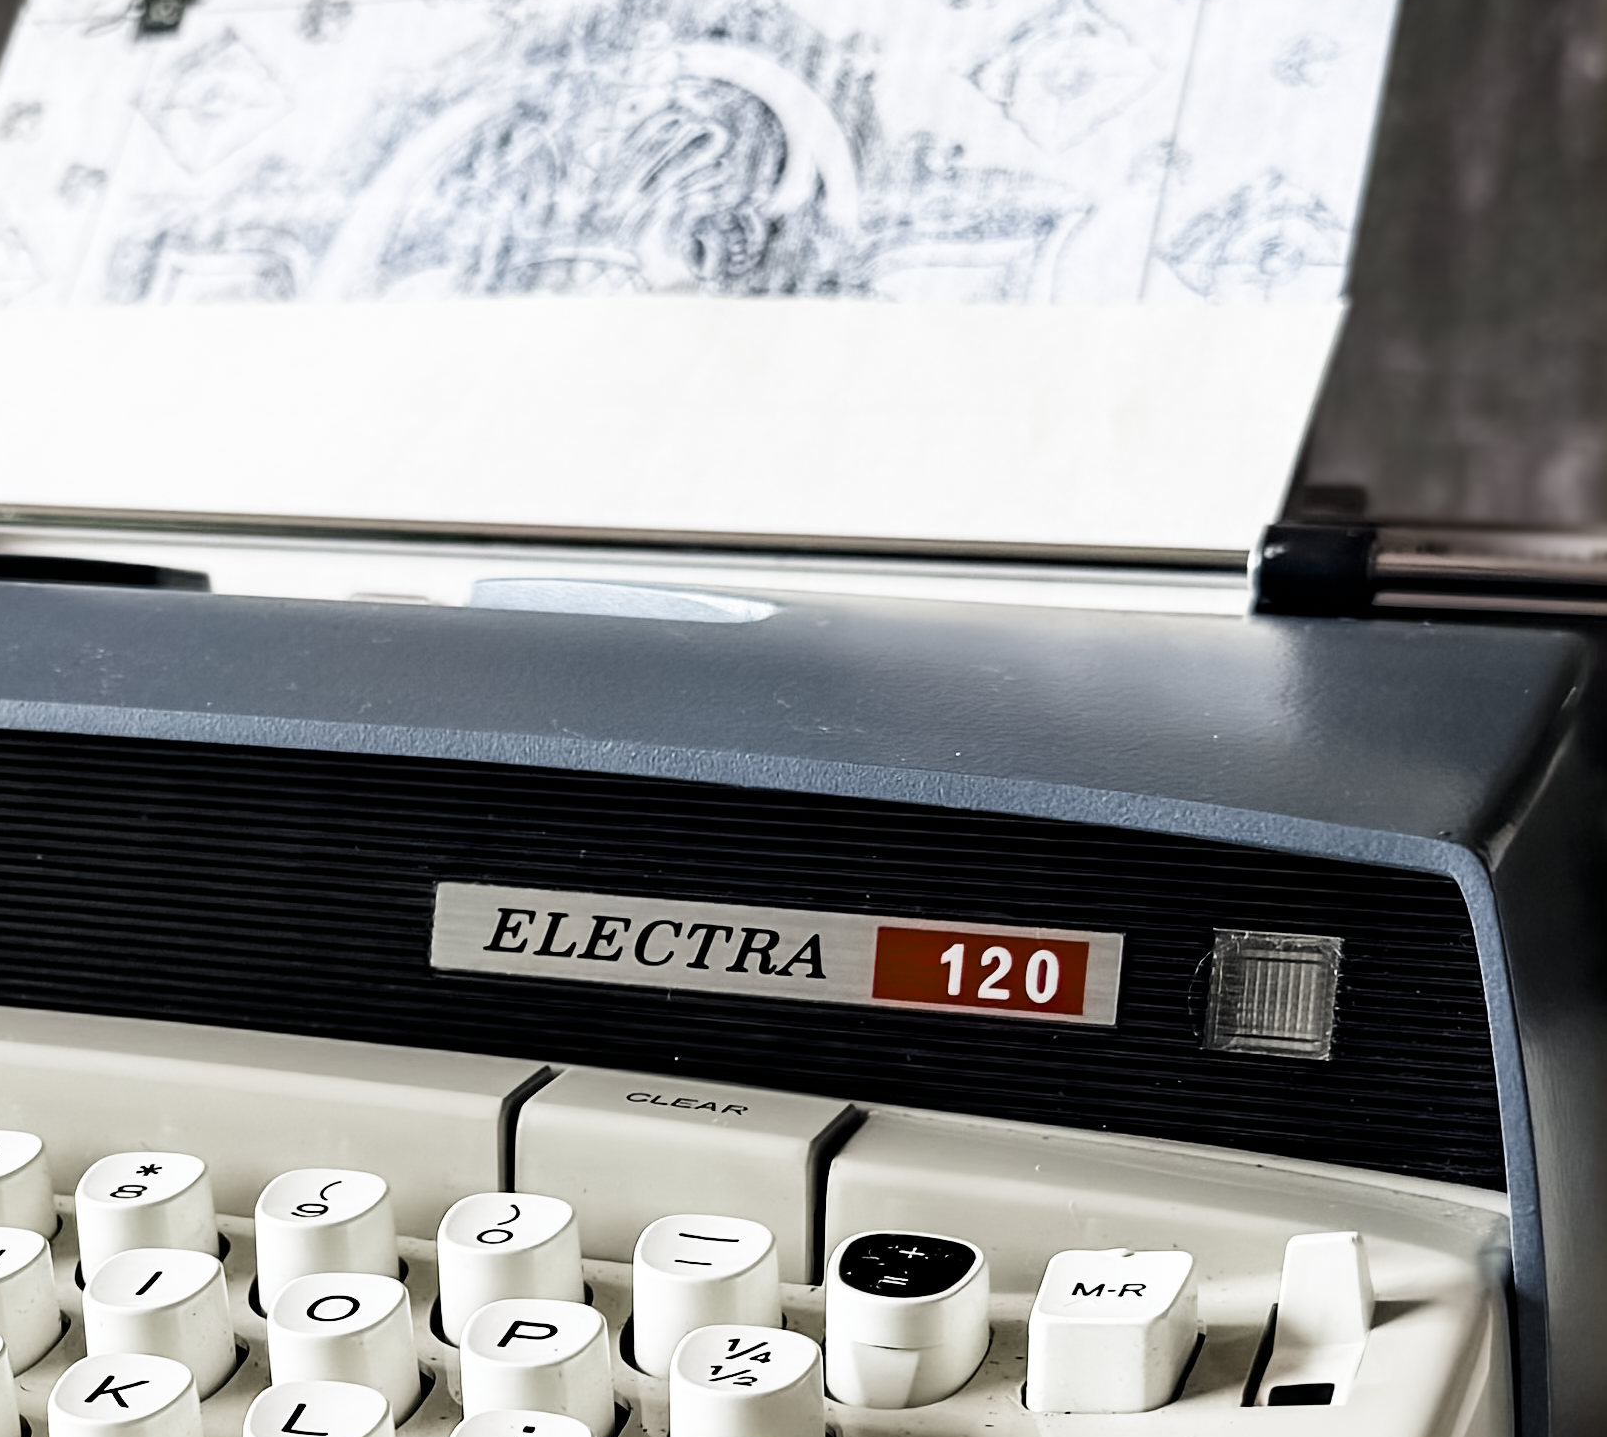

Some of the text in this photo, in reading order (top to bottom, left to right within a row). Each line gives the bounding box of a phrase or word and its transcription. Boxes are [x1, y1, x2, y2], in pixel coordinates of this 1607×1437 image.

[483, 908, 1059, 1004] ELECTRA 120
[626, 1093, 748, 1115] CLEAR
[110, 1185, 147, 1198] 8
[291, 1204, 328, 1217] 9
[136, 1271, 162, 1295] I
[1072, 1283, 1146, 1297] M-R
[307, 1296, 360, 1321] O
[497, 1321, 558, 1347] P
[85, 1376, 149, 1408] K
[281, 1404, 328, 1436] L
